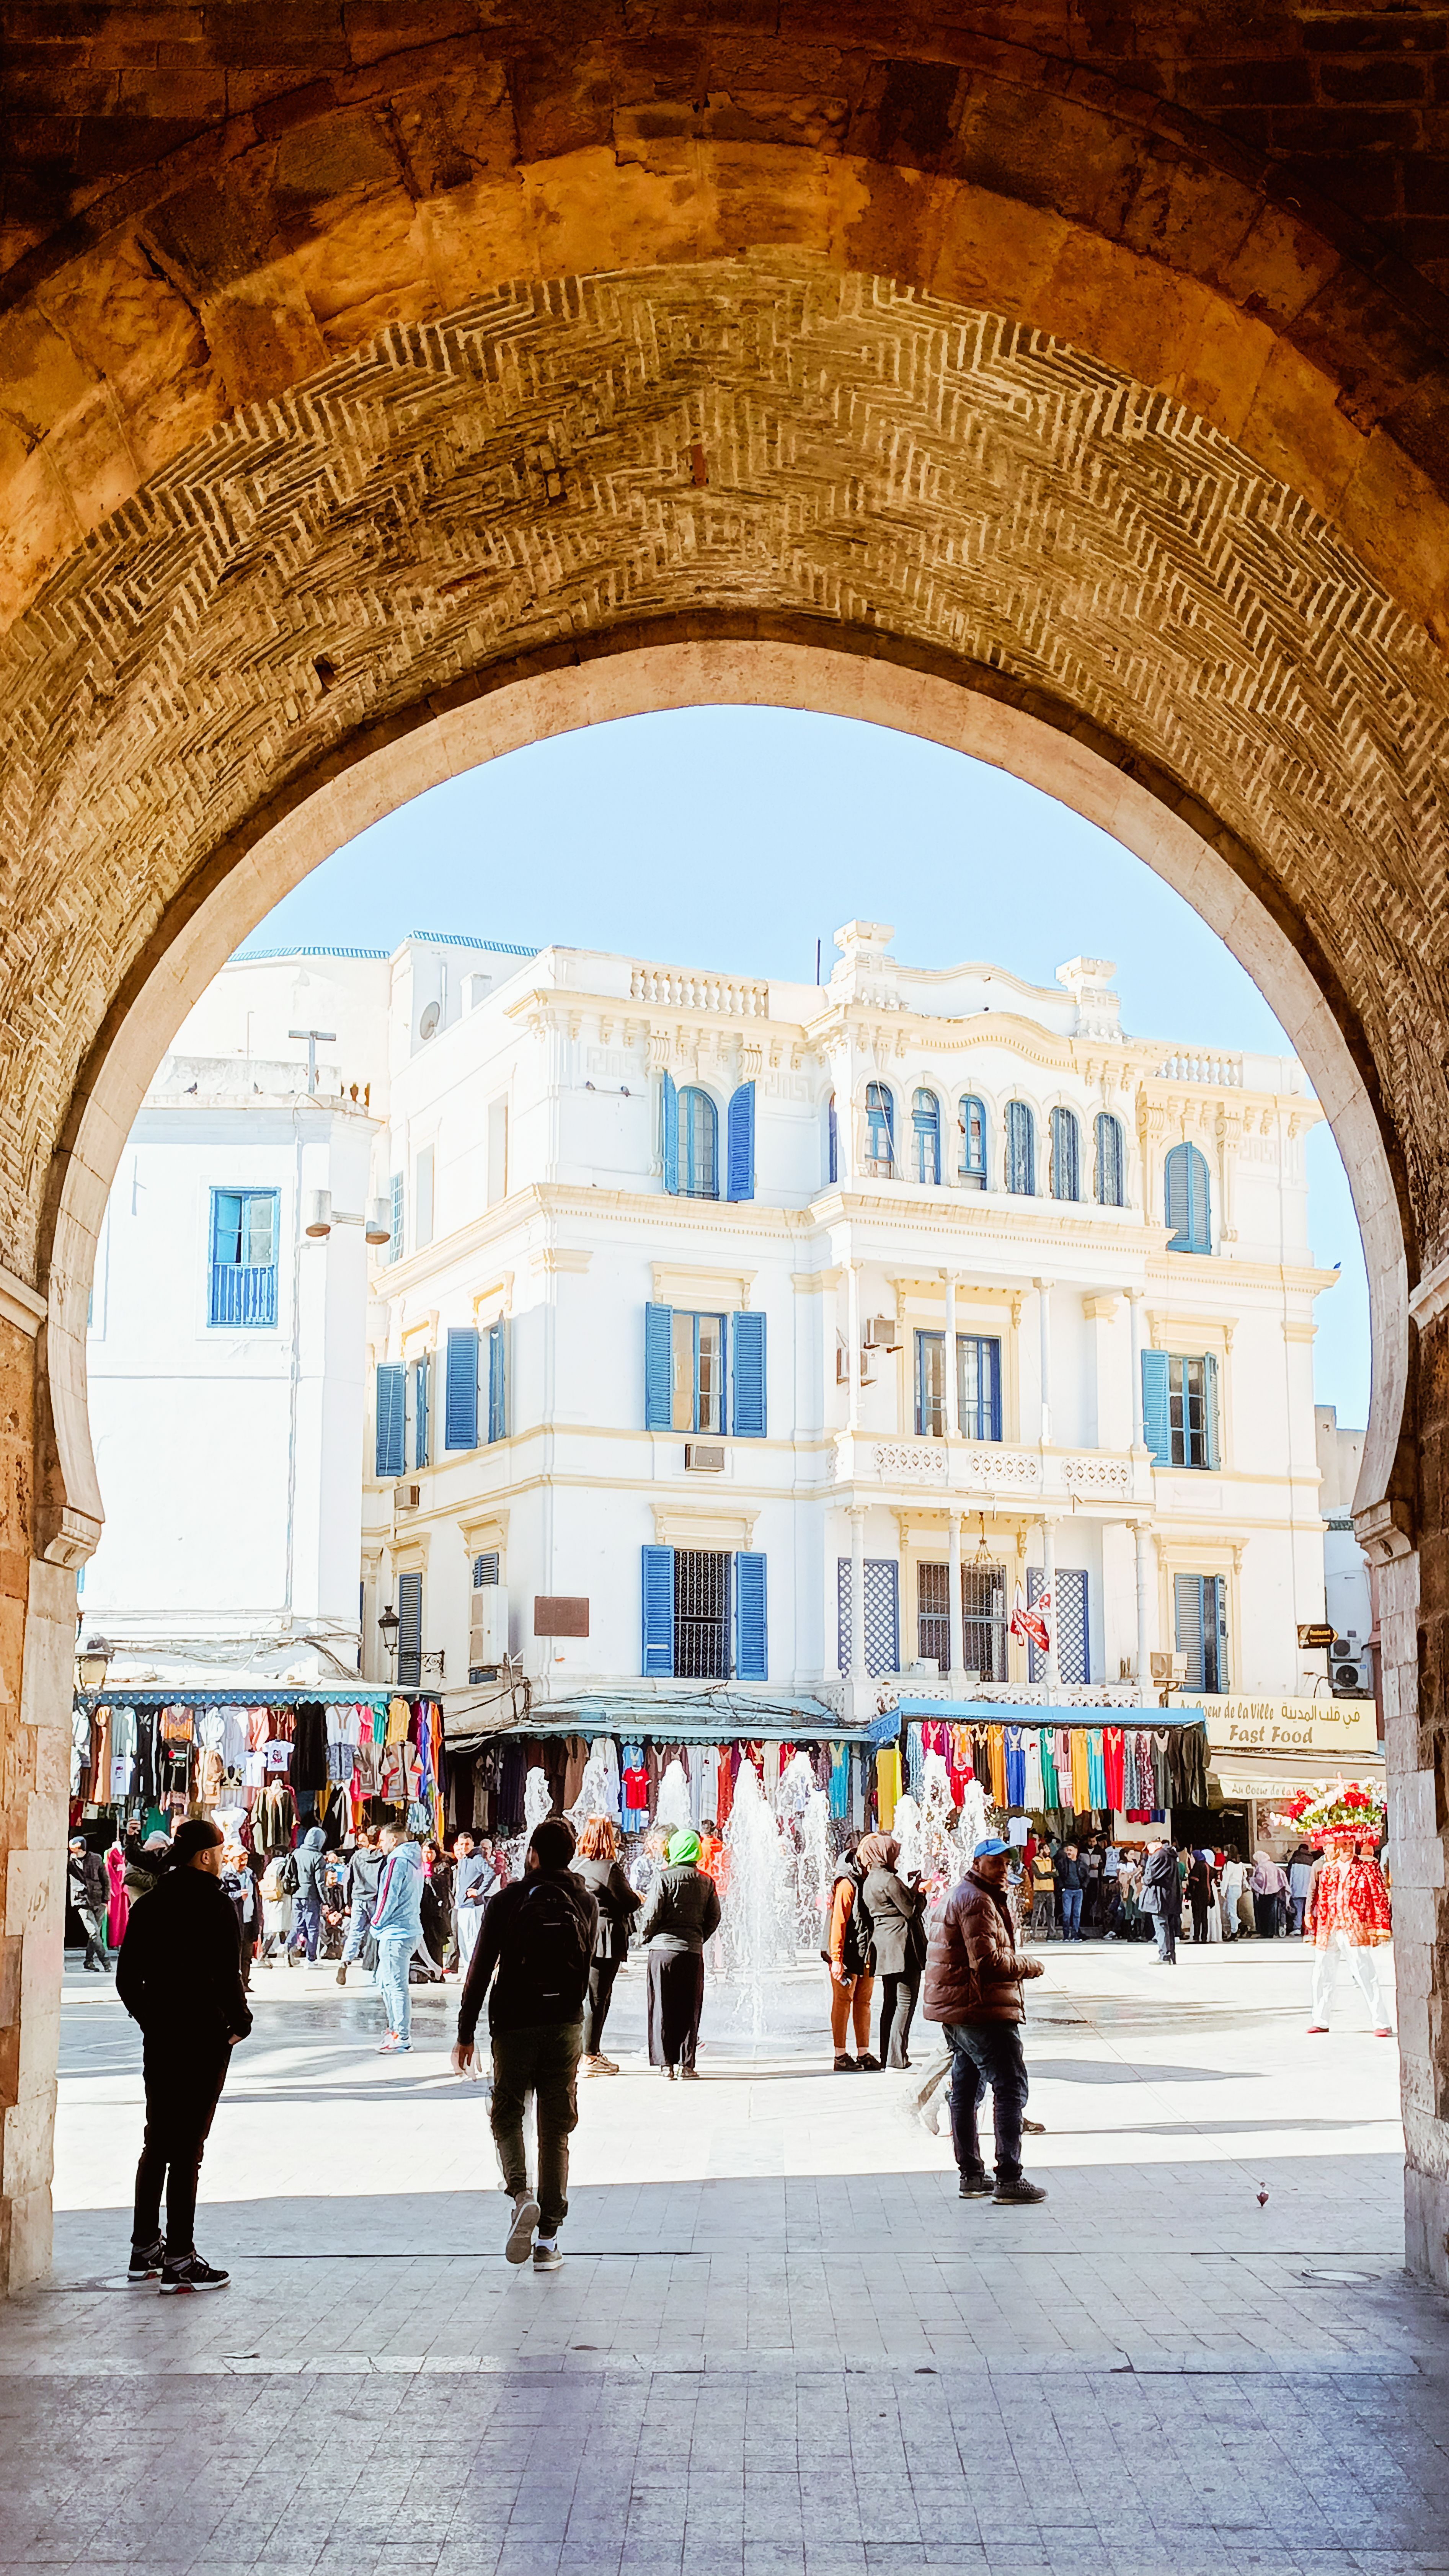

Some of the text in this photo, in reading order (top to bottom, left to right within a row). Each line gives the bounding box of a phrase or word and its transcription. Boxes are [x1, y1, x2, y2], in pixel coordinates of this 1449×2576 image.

[1225, 1701, 1235, 1718] de
[1238, 1702, 1248, 1719] la
[1251, 1703, 1274, 1720] Ville
[1281, 1702, 1360, 1729] في قلب المدينة
[1229, 1725, 1312, 1743] Fast Food
[1232, 1783, 1243, 1794] Au
[1245, 1784, 1268, 1795] Coeur
[1271, 1784, 1279, 1796] de
[1282, 1786, 1291, 1796] la
